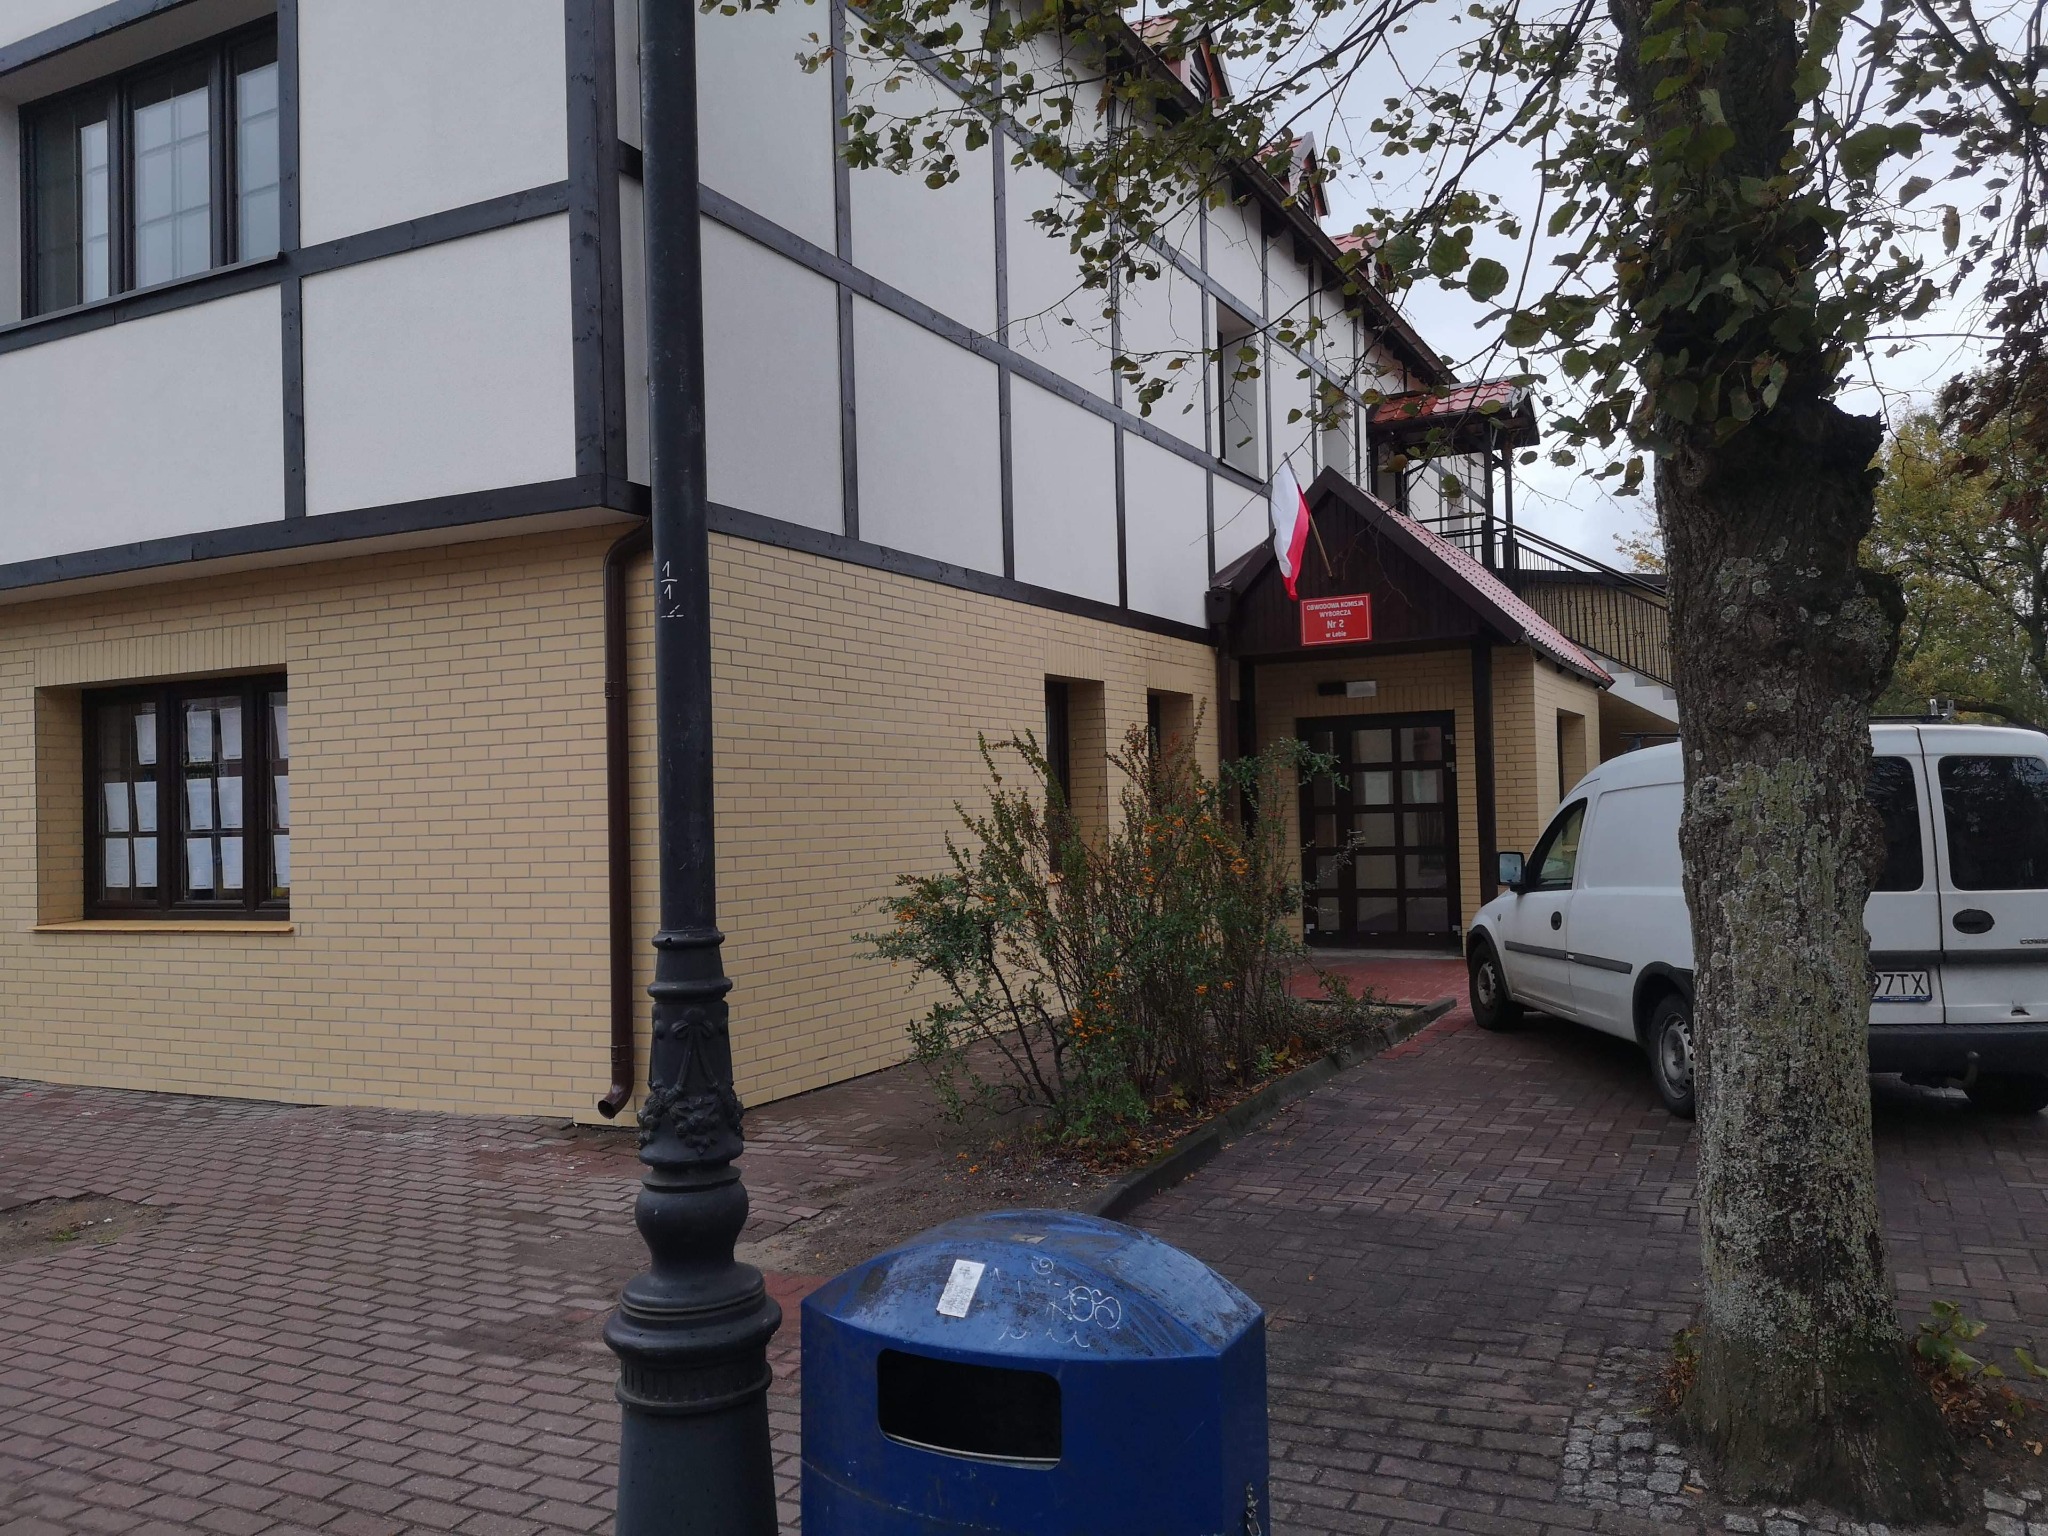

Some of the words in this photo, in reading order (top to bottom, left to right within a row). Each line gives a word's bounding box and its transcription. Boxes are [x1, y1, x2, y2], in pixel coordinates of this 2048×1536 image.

[1319, 609, 1352, 618] WYBORCZA
[1327, 620, 1336, 629] Nr
[1338, 619, 1345, 628] 2
